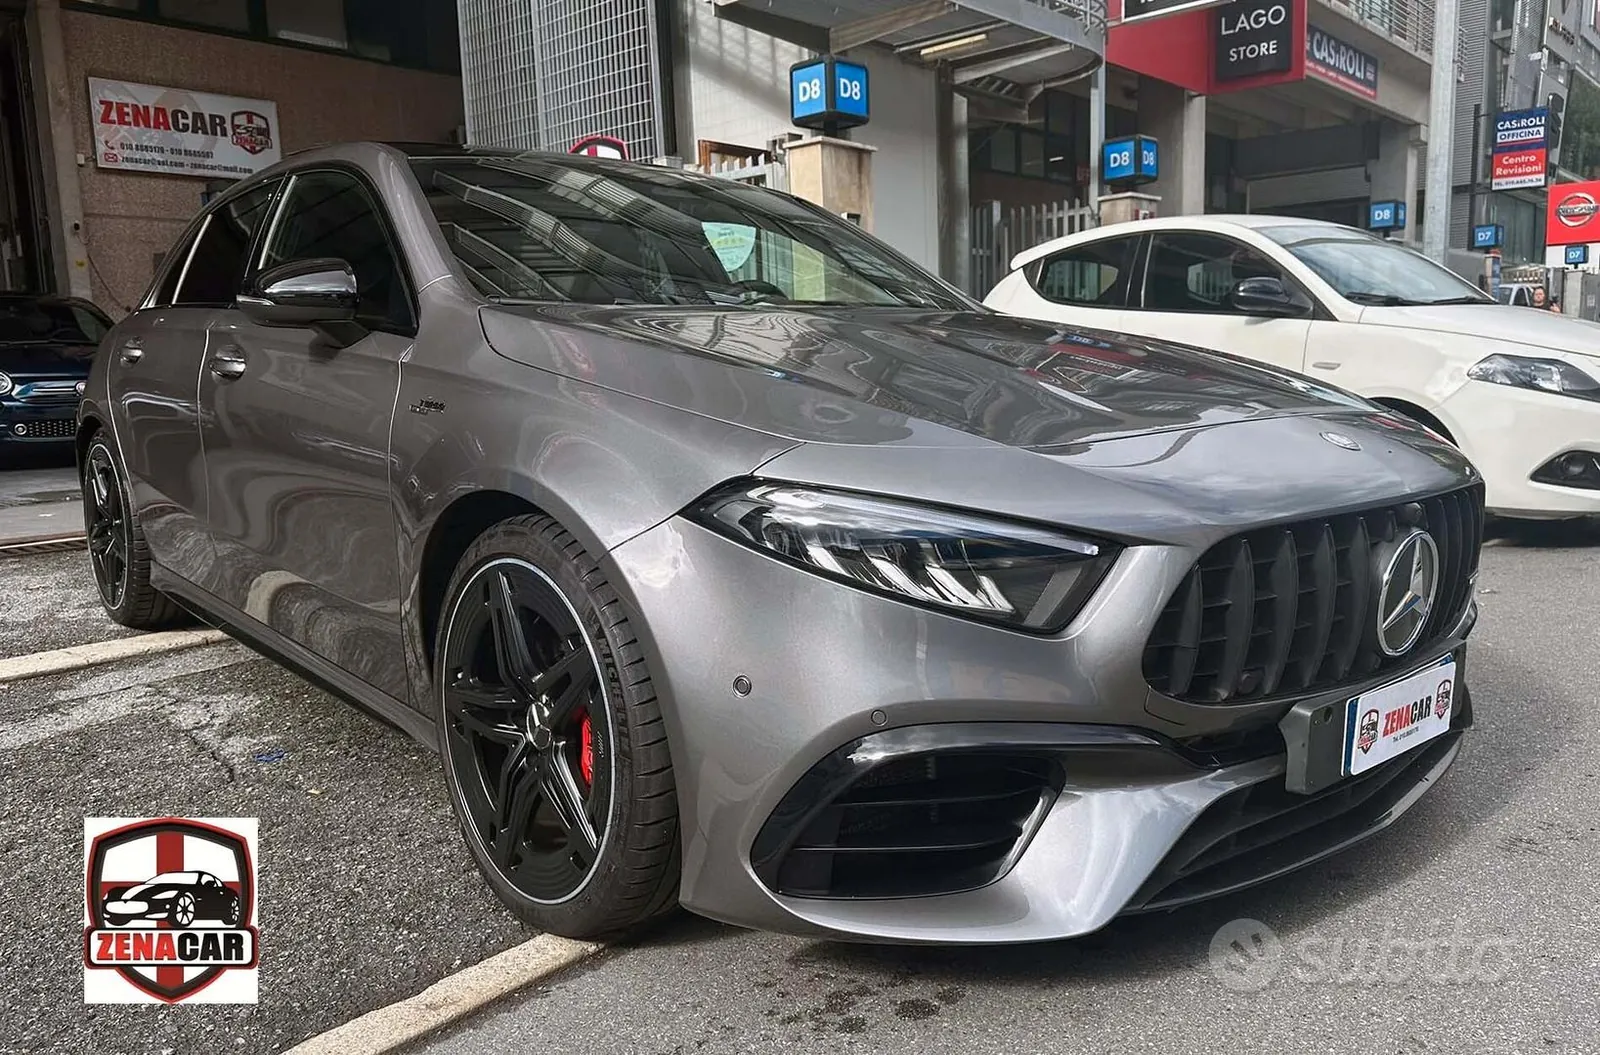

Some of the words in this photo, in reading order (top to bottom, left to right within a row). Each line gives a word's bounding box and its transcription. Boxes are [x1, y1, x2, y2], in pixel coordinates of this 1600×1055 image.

[1221, 5, 1286, 36] LAGO
[1229, 40, 1278, 62] STORE
[799, 78, 821, 103] D8
[840, 77, 861, 101] D8
[99, 100, 228, 138] ZENACAR
[1500, 129, 1541, 140] OFFICINA
[1110, 151, 1130, 168] D8
[1143, 150, 1155, 166] D8
[1502, 155, 1537, 165] Centro
[1496, 162, 1542, 176] Revisioni
[1374, 208, 1391, 221] D8
[1478, 231, 1492, 241] D7
[1569, 250, 1581, 259] D7
[1383, 696, 1432, 738] ZENACAR
